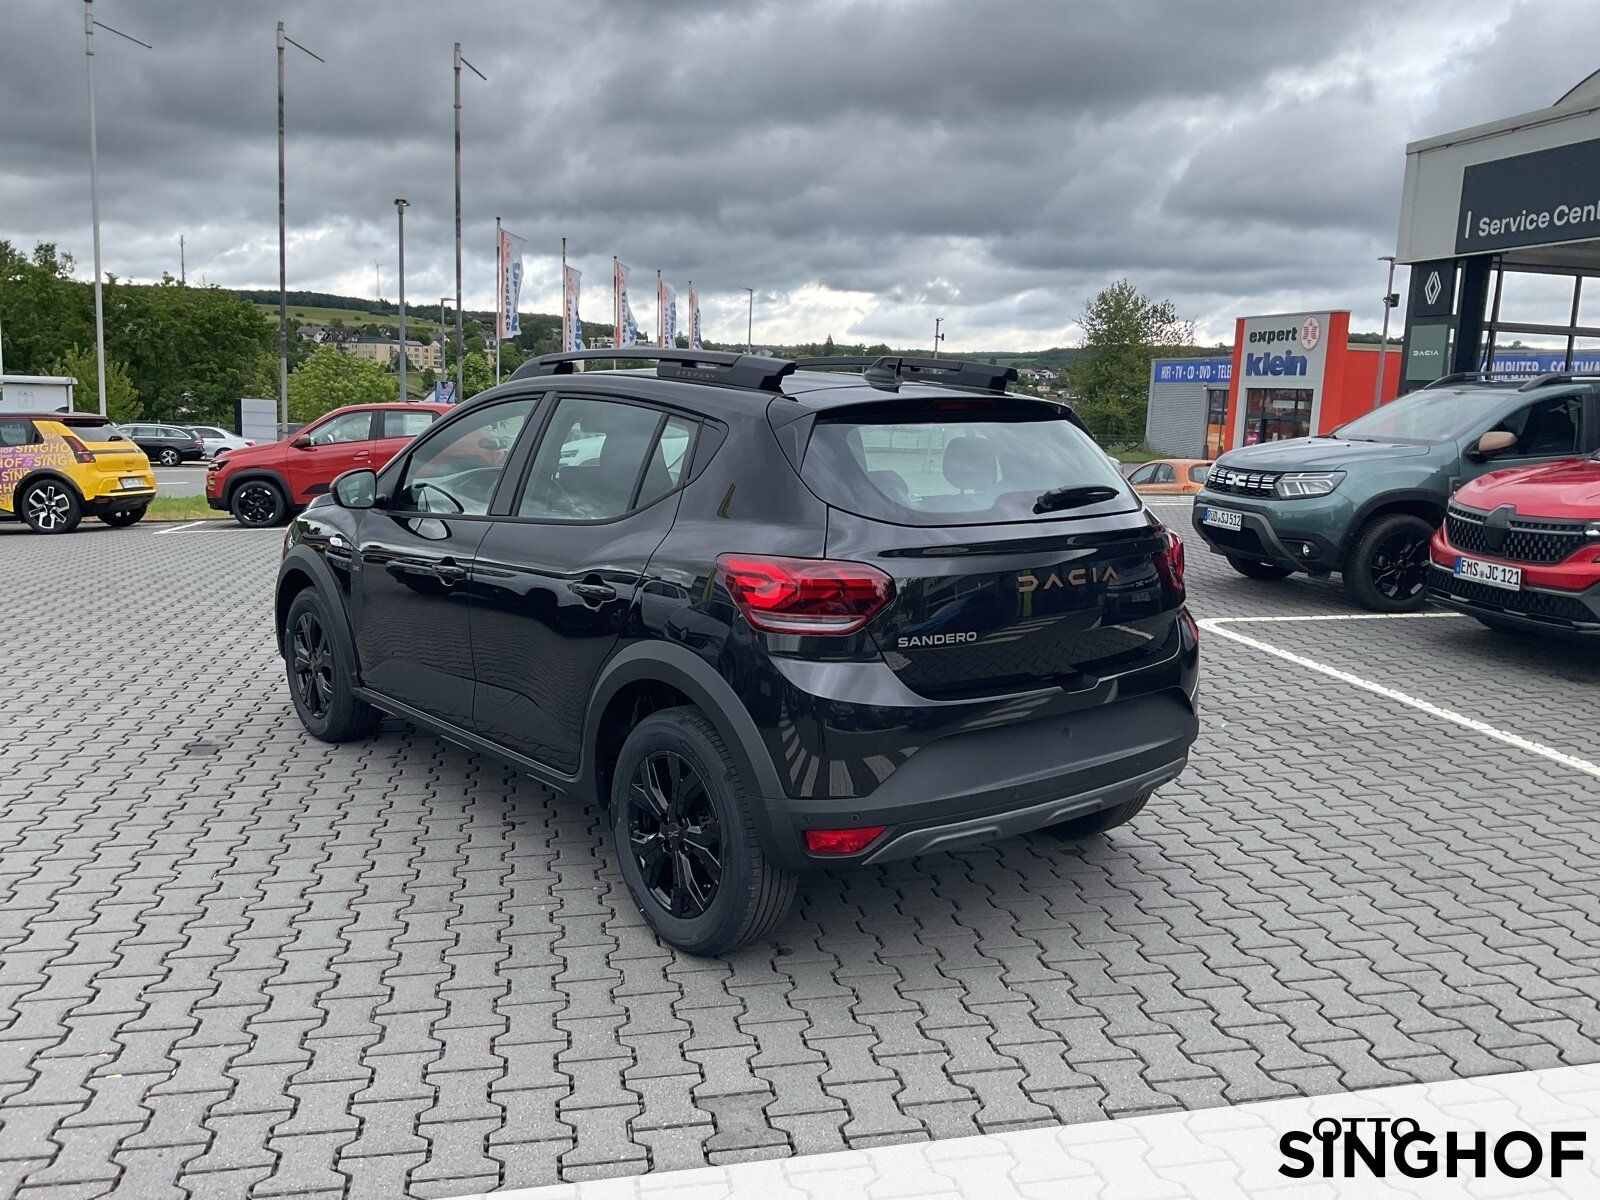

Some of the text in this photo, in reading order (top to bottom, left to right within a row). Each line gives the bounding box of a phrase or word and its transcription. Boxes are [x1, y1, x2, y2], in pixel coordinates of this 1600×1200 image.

[1478, 210, 1549, 237] Service
[1249, 327, 1298, 344] expert
[1175, 365, 1183, 379] TV
[1187, 365, 1195, 380] CD
[1199, 365, 1211, 379] DVD
[1246, 350, 1307, 376] klein
[1017, 566, 1118, 592] DACIA
[1461, 560, 1520, 585] EMS JC 121
[898, 631, 977, 648] SANDERO
